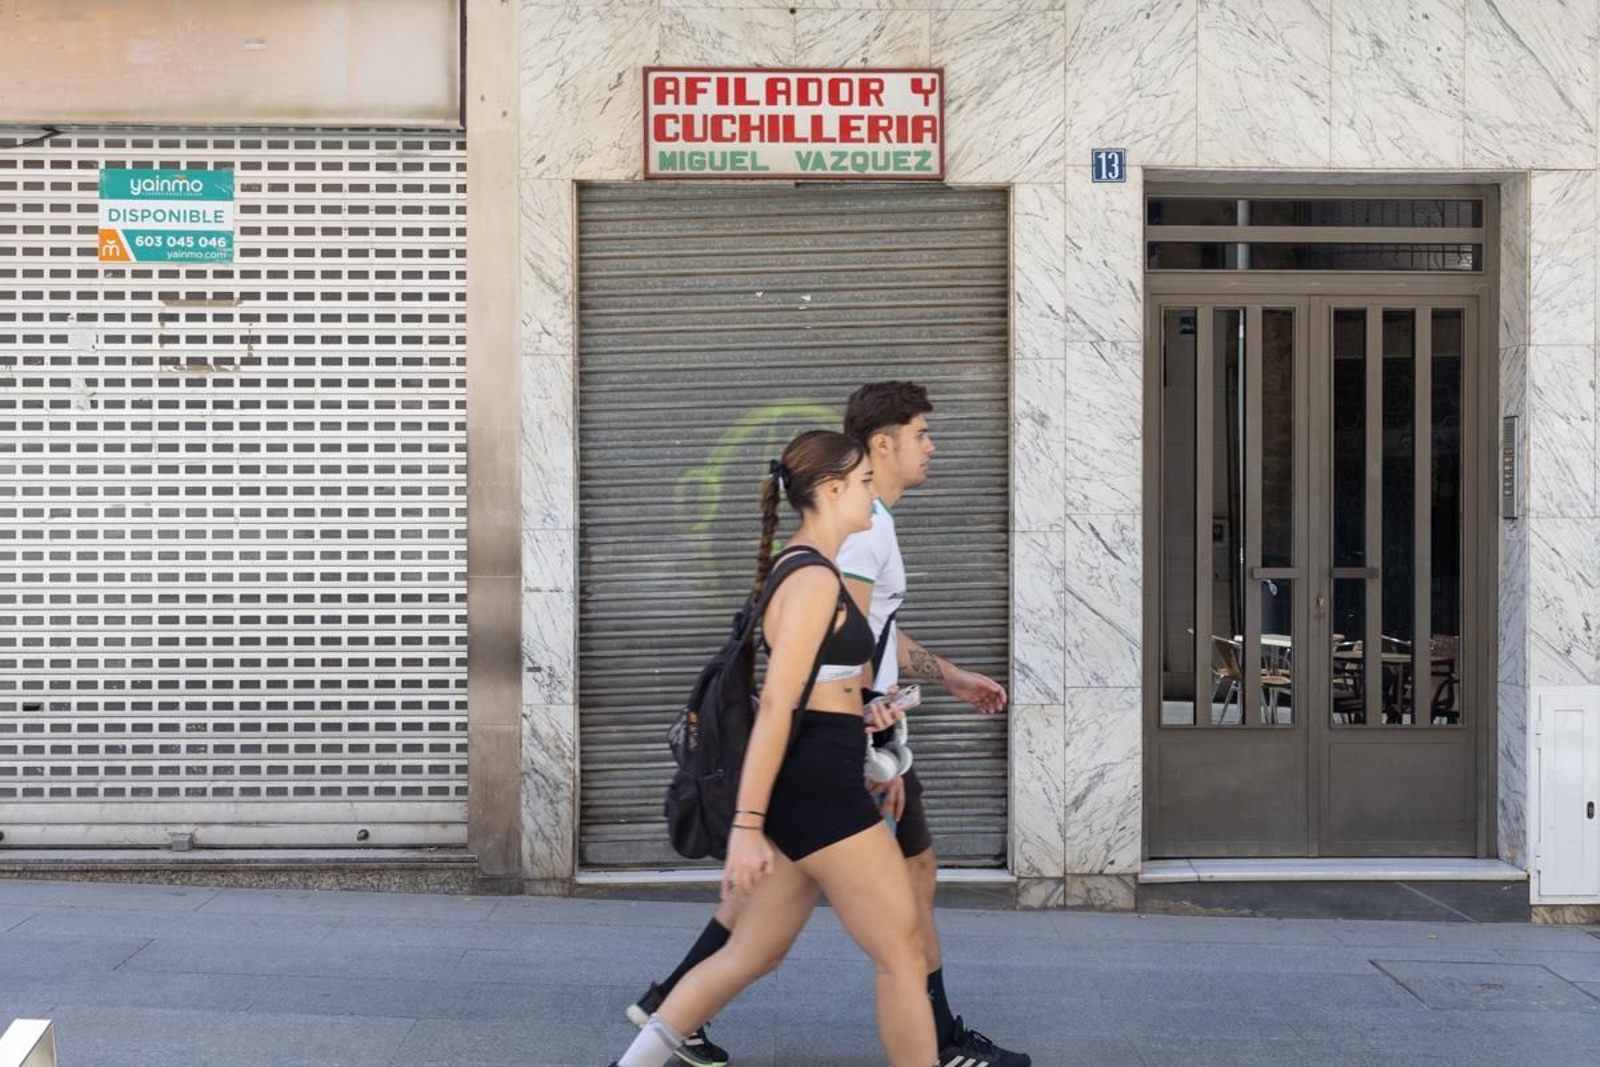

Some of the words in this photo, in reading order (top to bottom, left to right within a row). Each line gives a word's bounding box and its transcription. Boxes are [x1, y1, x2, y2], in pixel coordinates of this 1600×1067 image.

[653, 77, 884, 107] AFILADOR
[910, 77, 937, 107] Y
[653, 114, 937, 144] CUCHILLERIA
[658, 151, 770, 172] MIGUEL
[795, 151, 932, 173] VAZQUEZ
[1098, 152, 1119, 179] 13
[130, 175, 203, 196] yainmo
[108, 208, 225, 224] DISPONIBLE
[135, 236, 163, 247] 603
[166, 236, 194, 248] 045
[198, 236, 226, 248] 046
[167, 251, 226, 260] yainmo.com
